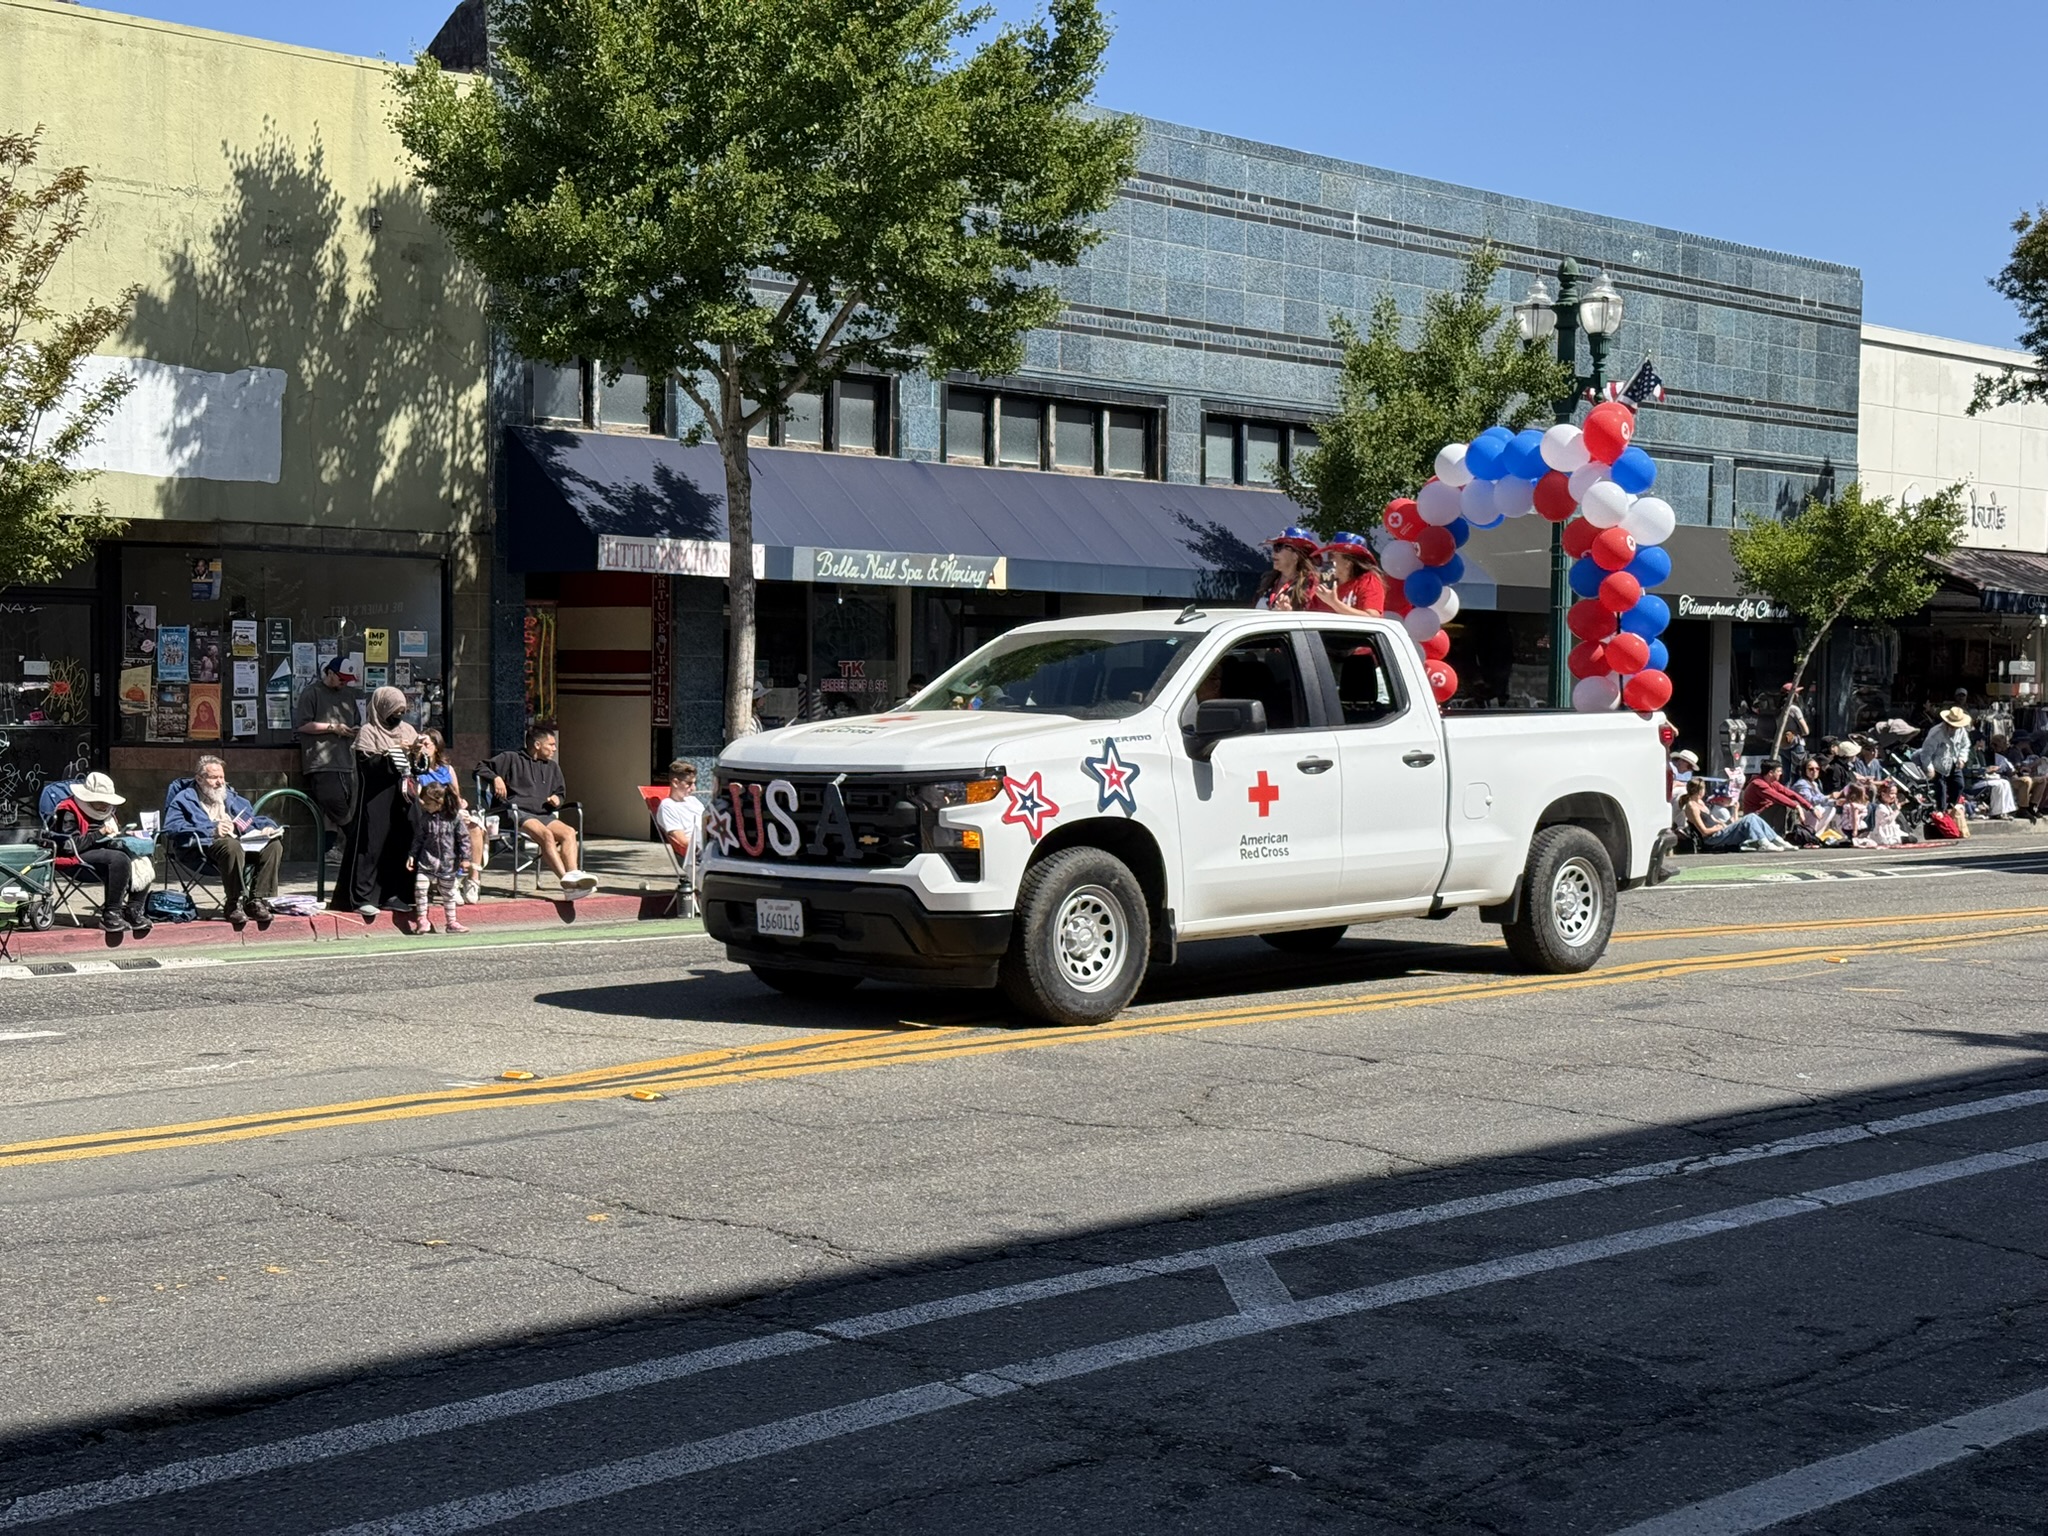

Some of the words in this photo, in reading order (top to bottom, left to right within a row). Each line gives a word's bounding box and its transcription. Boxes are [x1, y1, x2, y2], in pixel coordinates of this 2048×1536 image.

[605, 542, 656, 569] LITTLE
[817, 551, 859, 577] Bella
[860, 553, 896, 580] Nail
[898, 558, 924, 583] Spa
[926, 557, 939, 582] &
[940, 559, 986, 588] Waxing
[657, 574, 667, 633] RTUNE
[1679, 594, 1736, 619] Triumphant
[1735, 599, 1754, 621] Life
[1755, 600, 1789, 619] Church
[838, 660, 866, 678] TK
[657, 655, 667, 716] TELLER
[1089, 734, 1152, 745] SILERADO
[729, 779, 864, 859] USA
[1239, 833, 1288, 846] American
[1240, 847, 1260, 860] Red
[1261, 846, 1289, 859] Cross
[760, 912, 800, 931] 1660116
